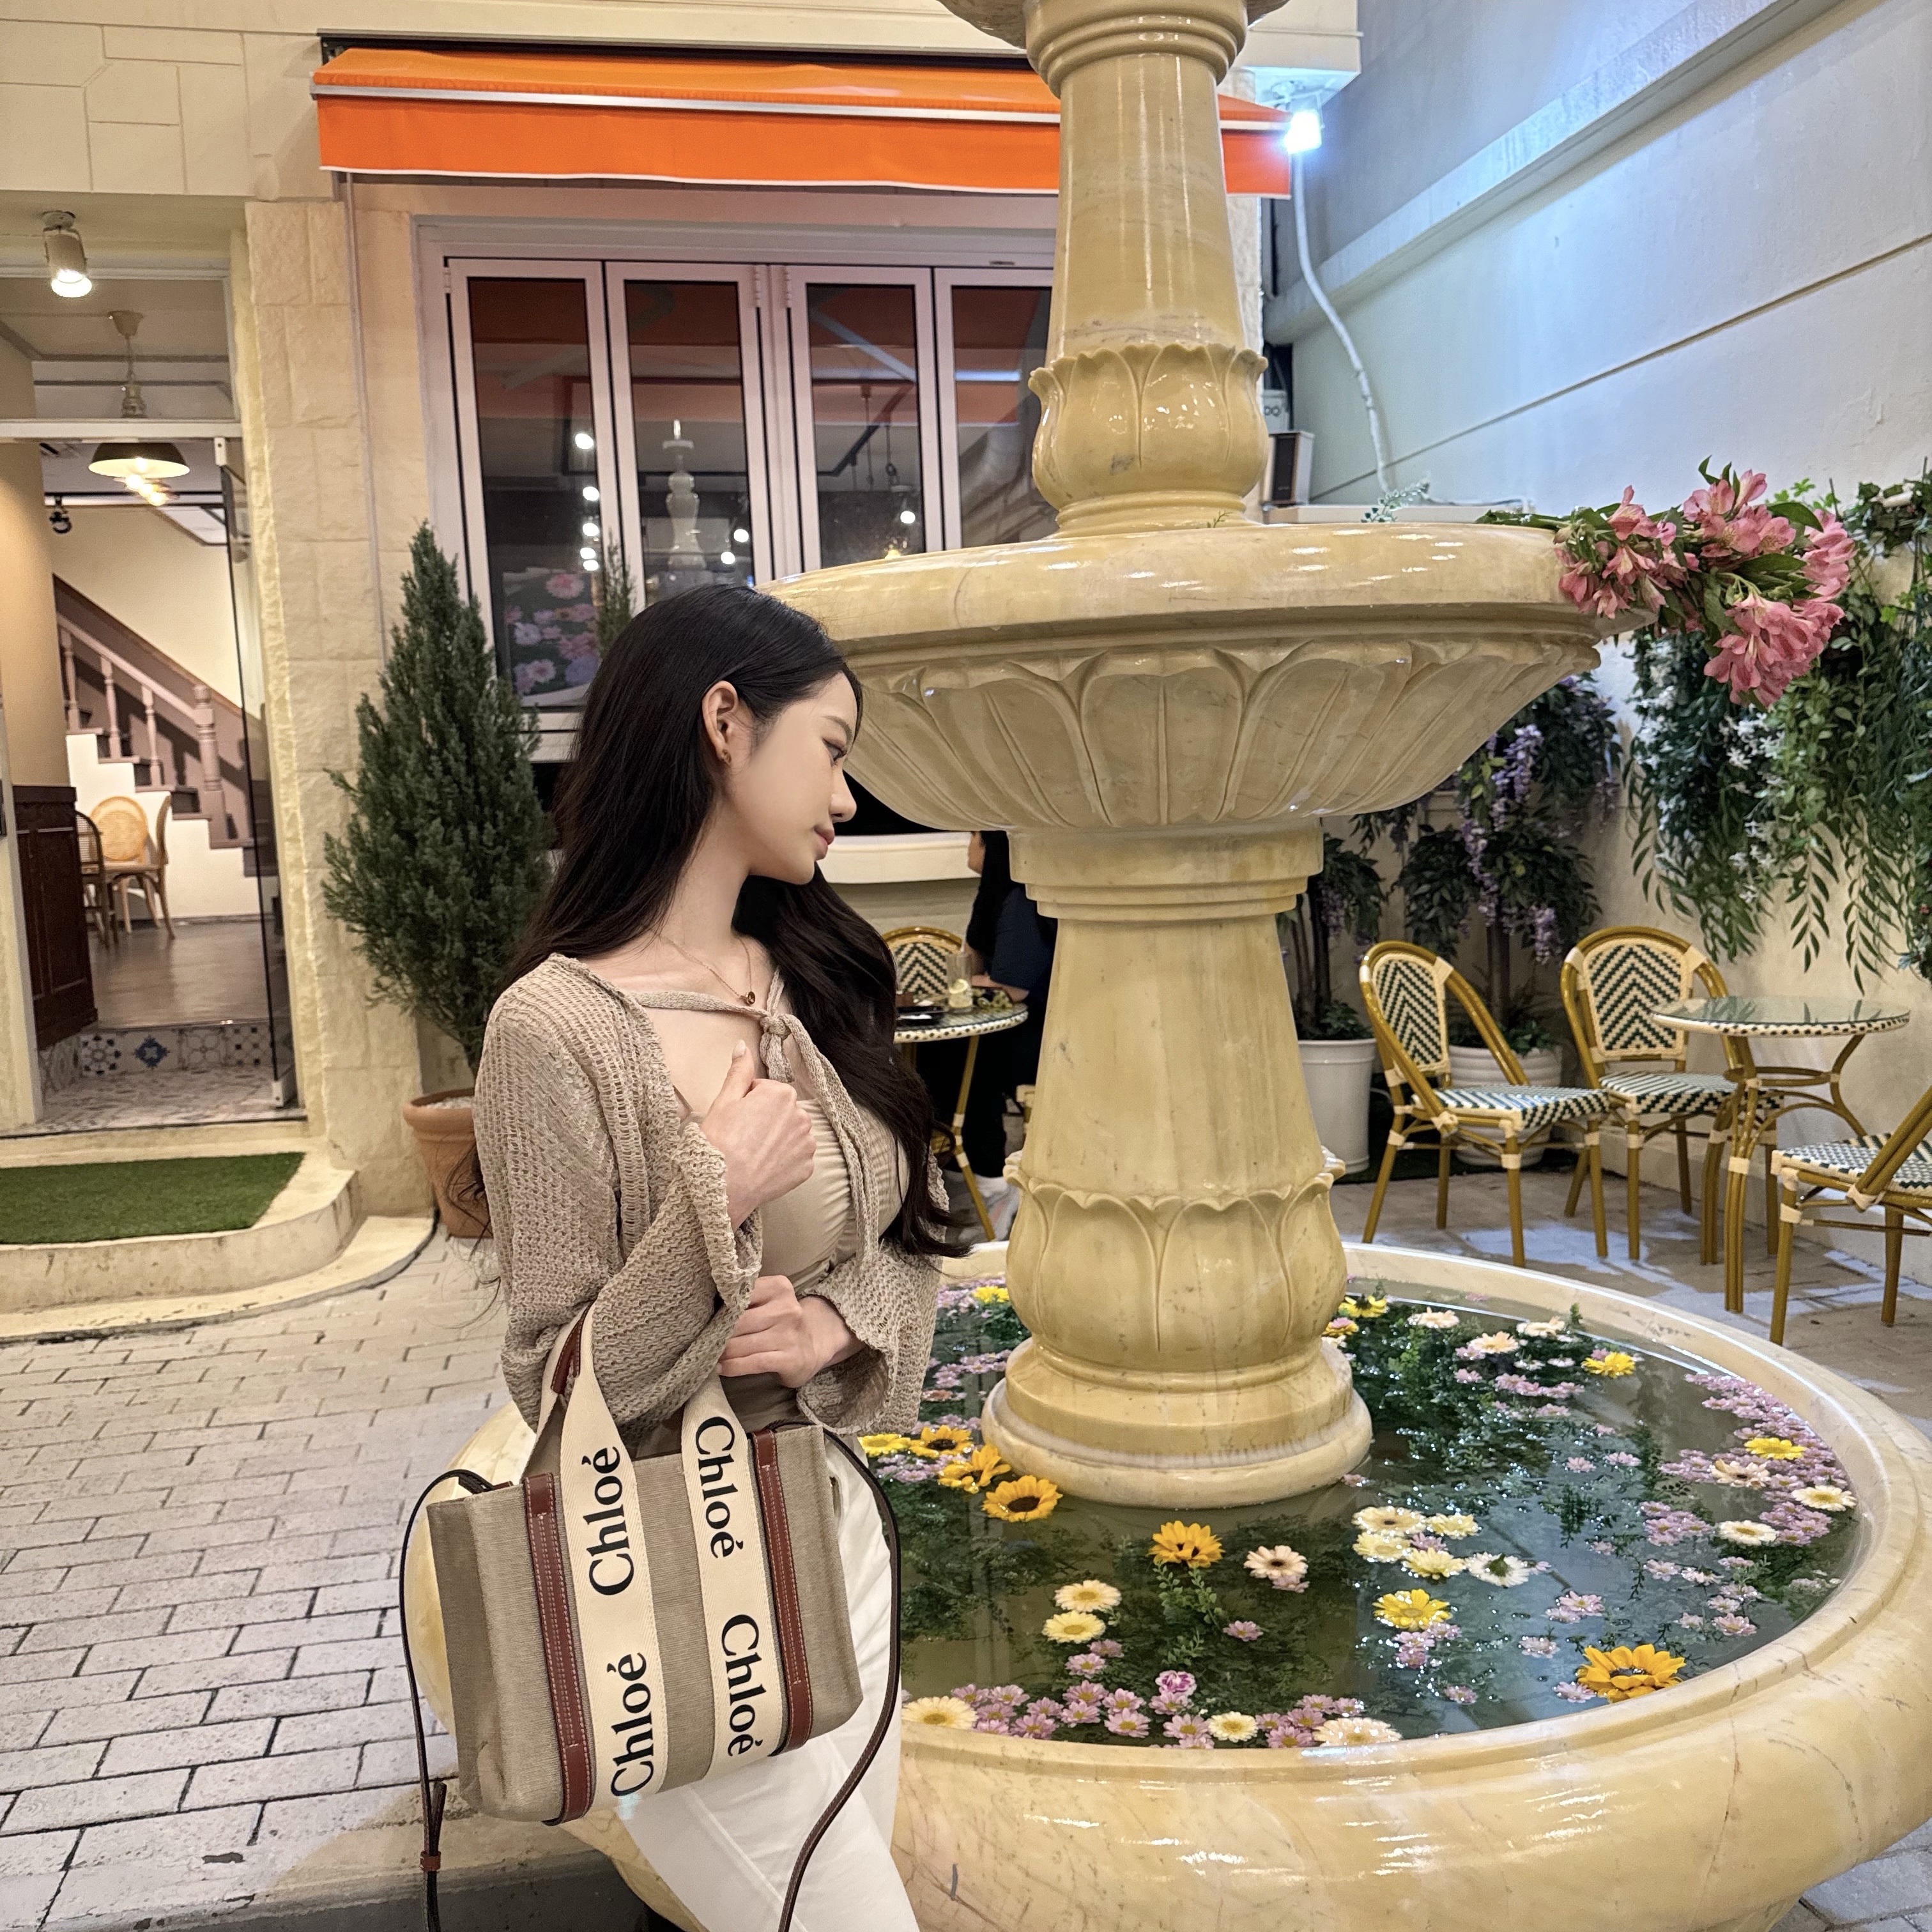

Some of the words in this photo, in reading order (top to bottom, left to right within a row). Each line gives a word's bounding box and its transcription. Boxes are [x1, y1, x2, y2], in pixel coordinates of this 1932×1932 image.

[581, 1446, 634, 1596] Chloé
[695, 1416, 744, 1558] Chloé
[721, 1614, 767, 1757] Chloé
[607, 1652, 654, 1797] Chloé
